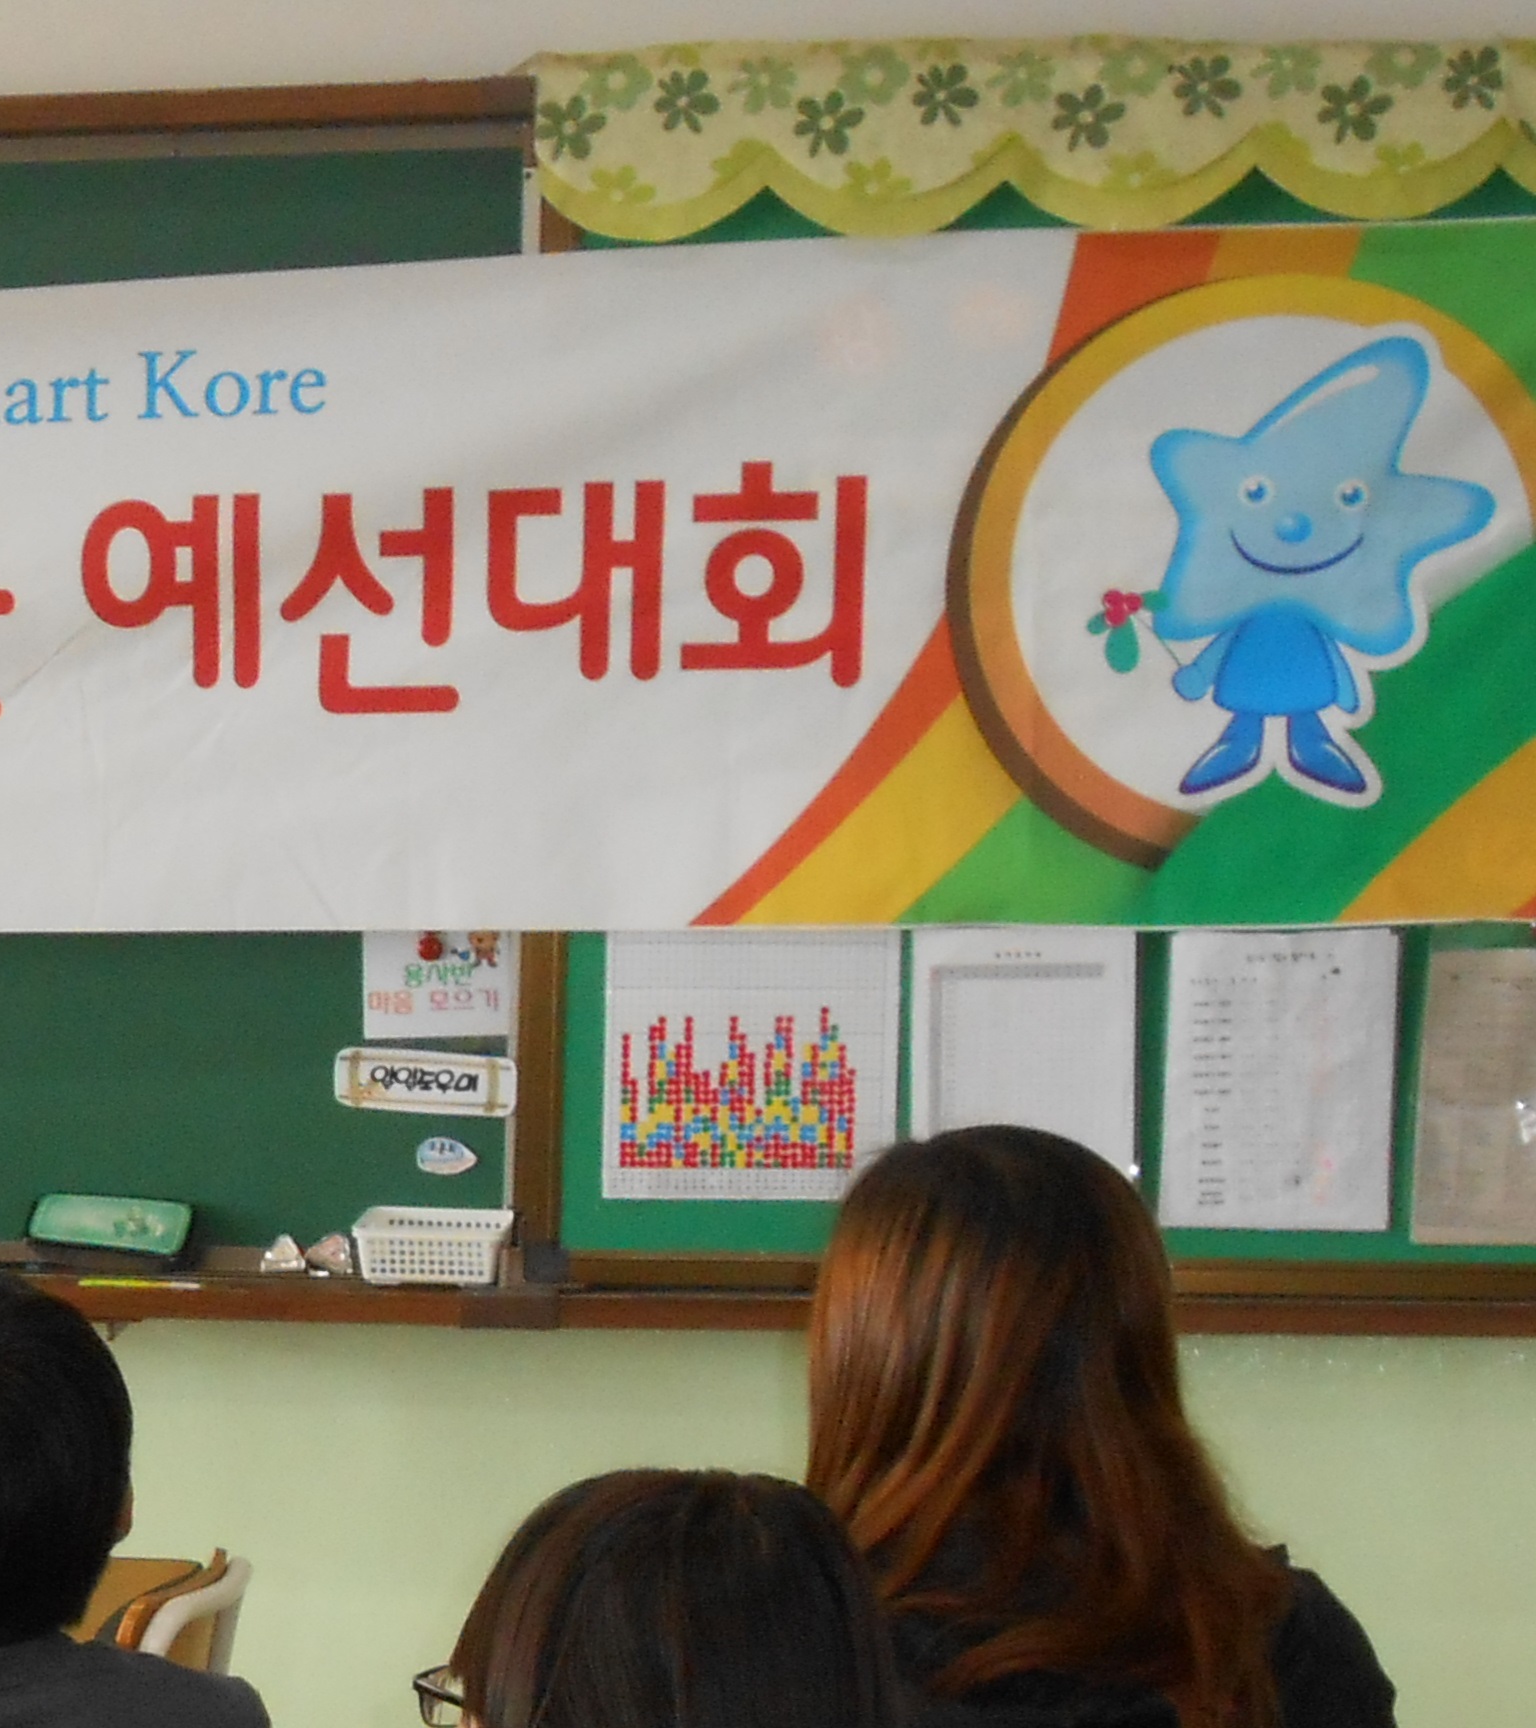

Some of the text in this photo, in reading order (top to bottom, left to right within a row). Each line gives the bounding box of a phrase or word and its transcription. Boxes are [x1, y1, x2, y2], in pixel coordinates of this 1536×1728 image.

[137, 348, 328, 421] Kore
[80, 460, 870, 715] 예선대회
[367, 988, 499, 1015] 마음 모으기
